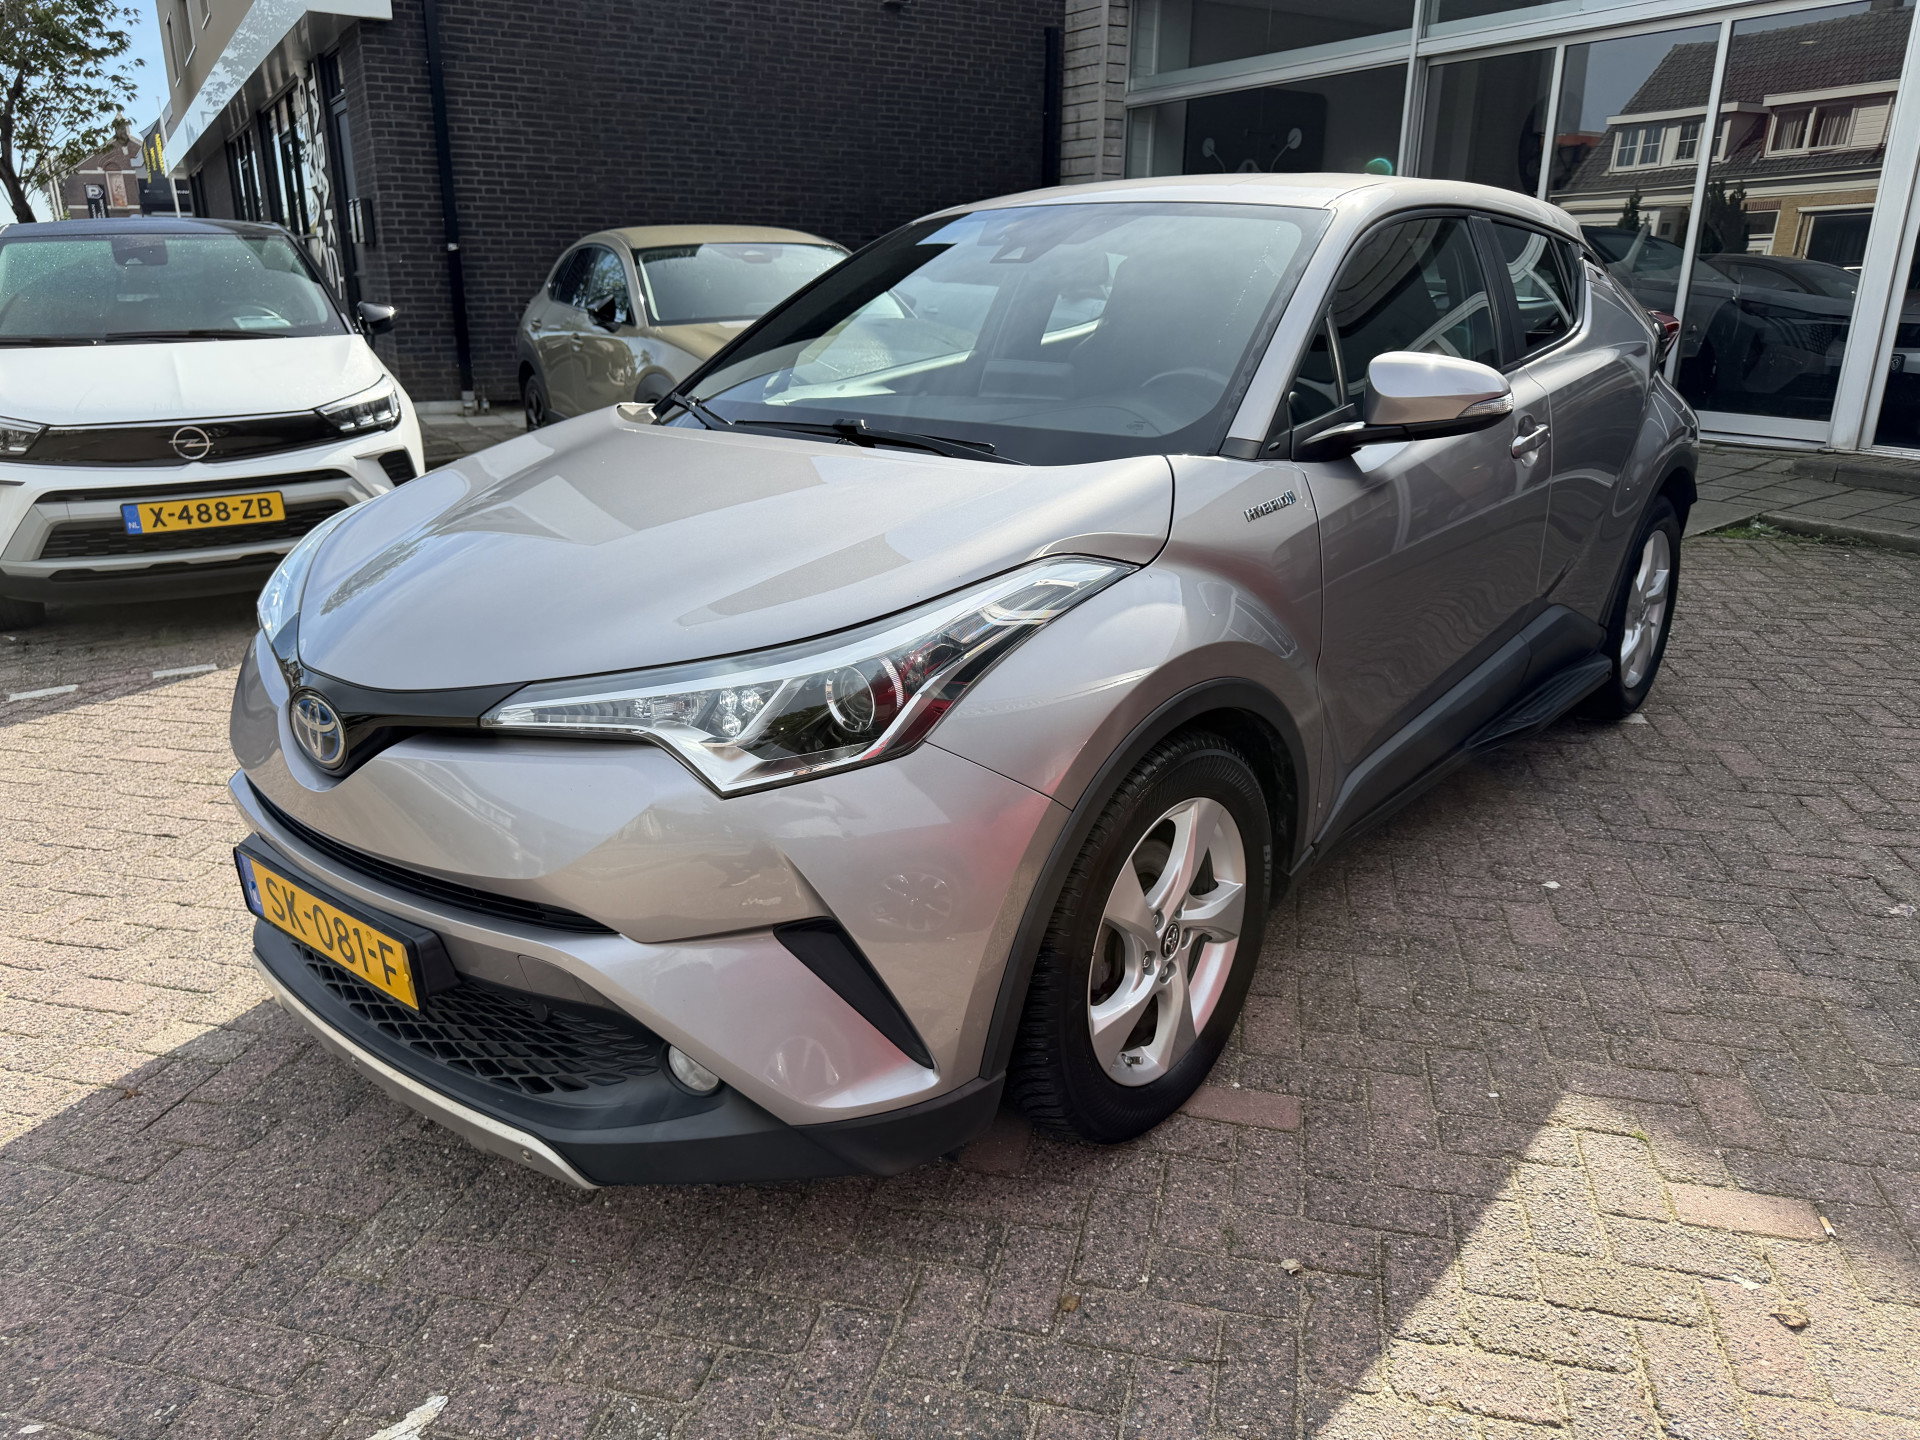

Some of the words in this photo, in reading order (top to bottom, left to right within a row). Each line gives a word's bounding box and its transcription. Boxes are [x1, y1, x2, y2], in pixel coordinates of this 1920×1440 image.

[149, 497, 273, 528] X-488-ZB
[1244, 494, 1290, 522] HYBRID
[128, 521, 140, 529] NL
[265, 877, 397, 986] SK-081-F
